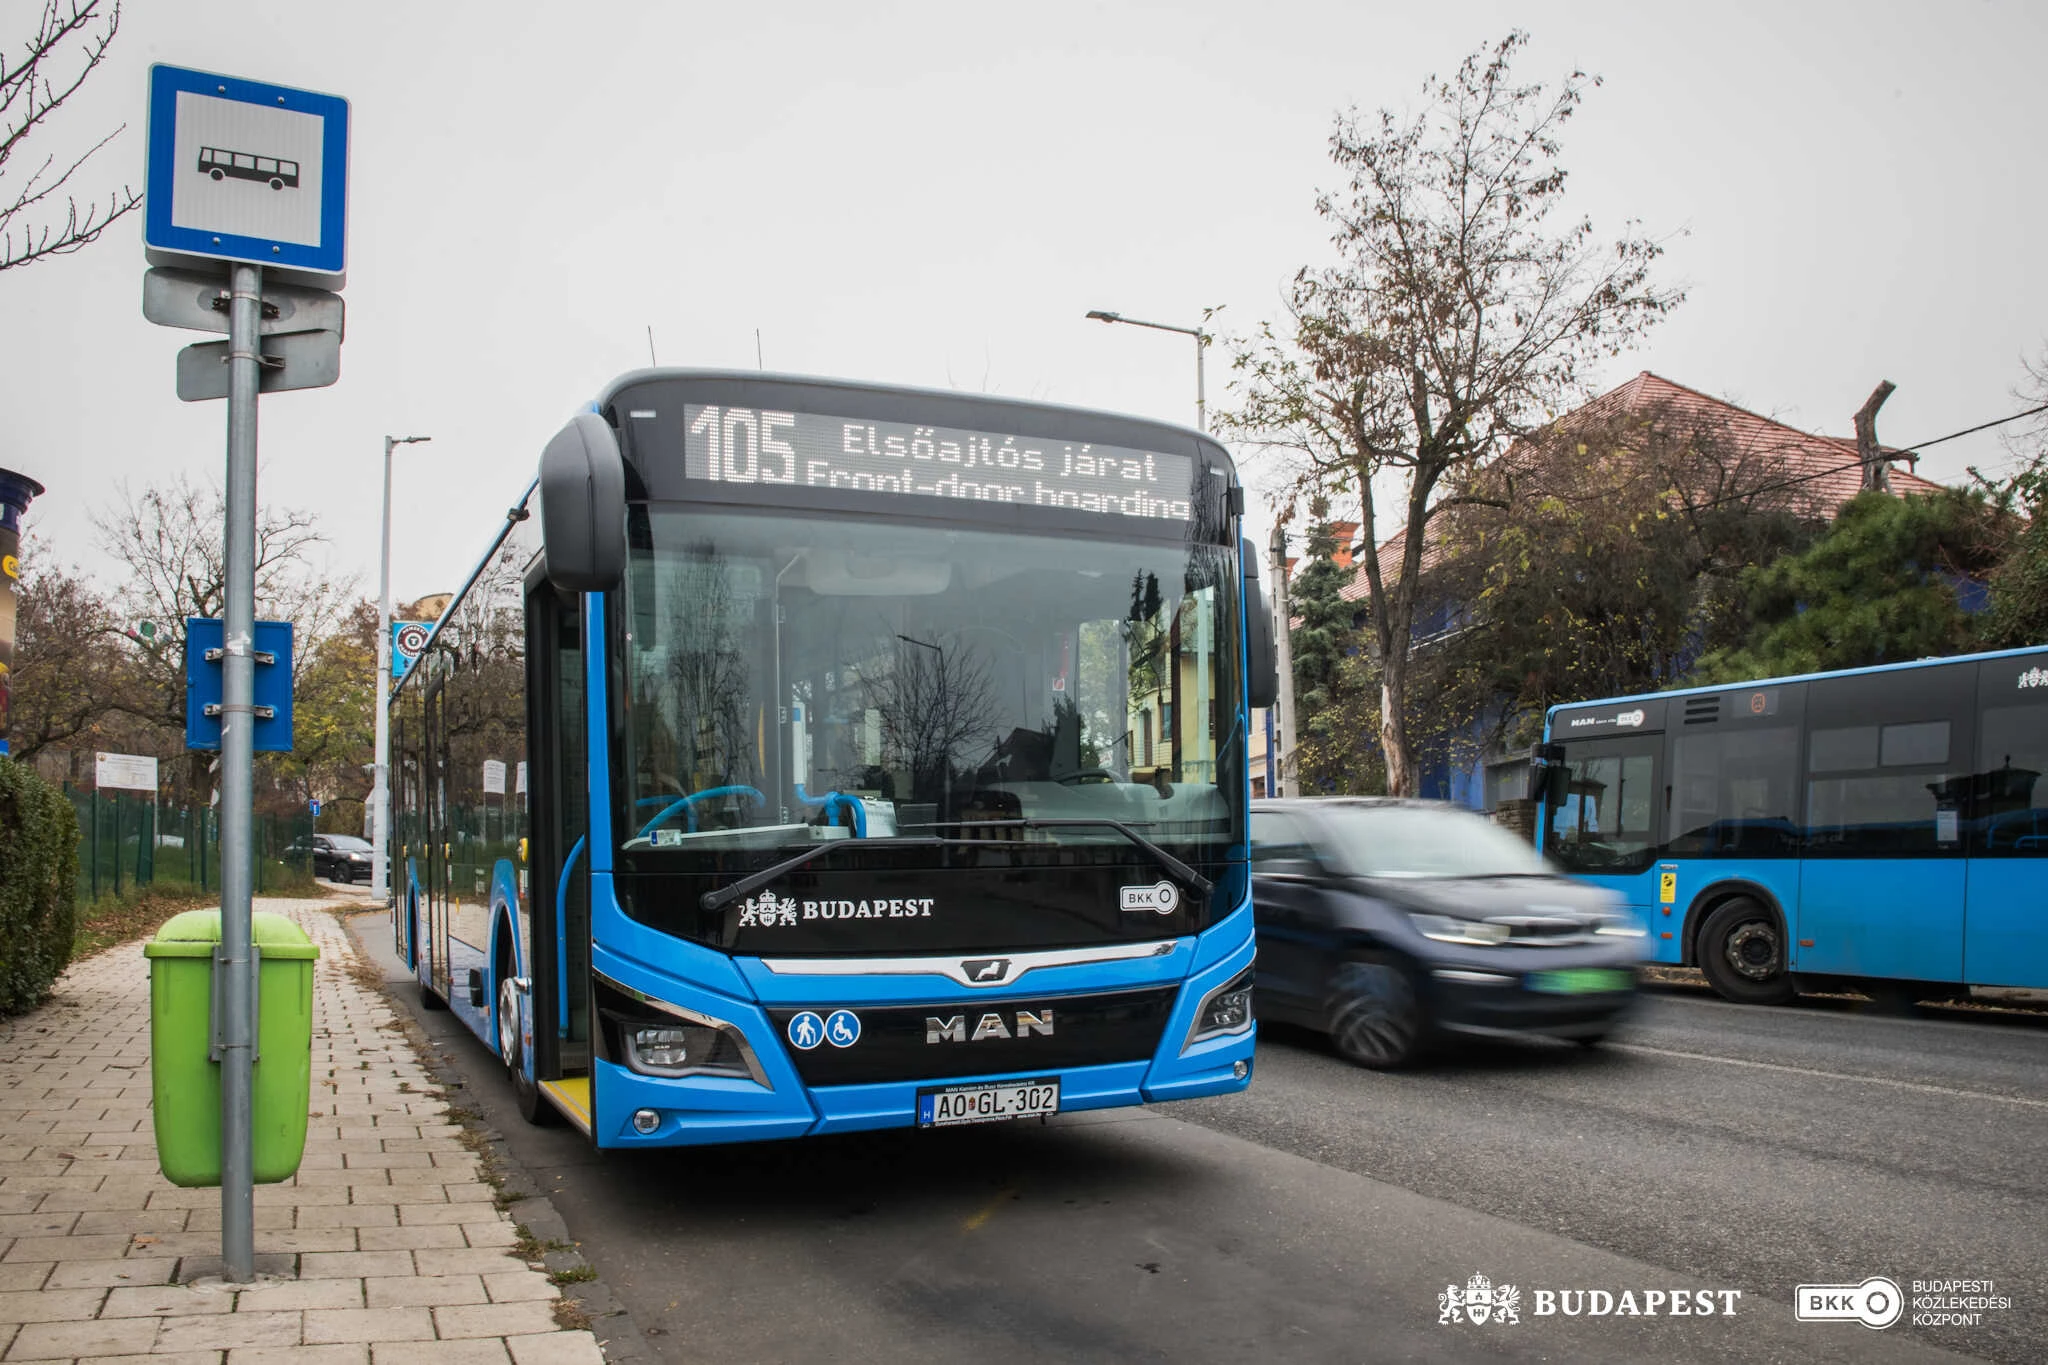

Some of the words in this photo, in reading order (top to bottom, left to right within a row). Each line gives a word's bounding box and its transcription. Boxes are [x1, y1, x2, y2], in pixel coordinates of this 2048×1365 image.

[691, 405, 795, 483] 105
[843, 424, 1045, 470] Elsőajtós
[1060, 444, 1158, 481] járat
[802, 899, 934, 920] BUDAPEST
[1128, 893, 1153, 903] BKK
[926, 1009, 1054, 1044] MAN
[978, 1087, 1053, 1114] GL-302
[923, 1111, 931, 1120] H
